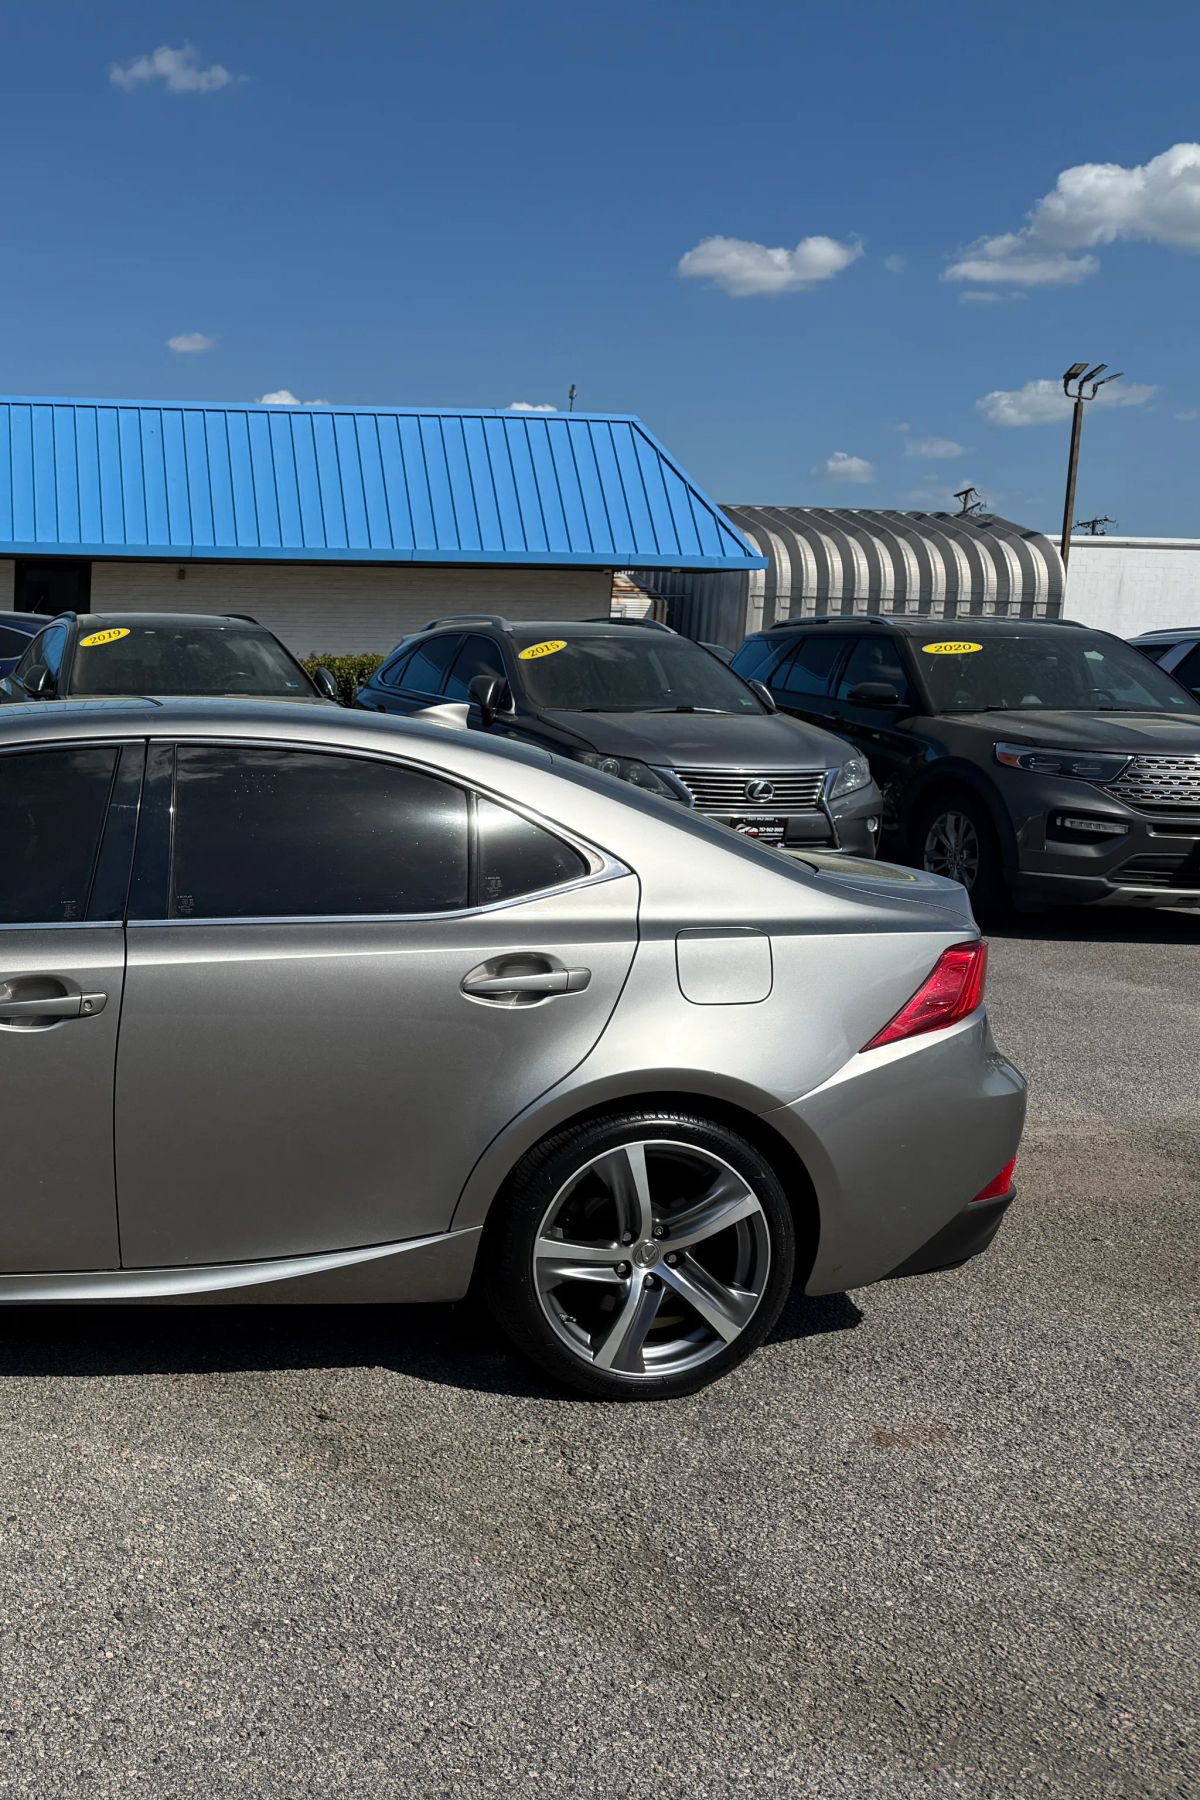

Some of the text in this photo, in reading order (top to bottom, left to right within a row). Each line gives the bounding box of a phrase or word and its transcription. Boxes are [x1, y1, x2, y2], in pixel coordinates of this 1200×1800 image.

[89, 629, 121, 644] 2019
[527, 641, 560, 657] 2015
[933, 643, 972, 653] 2020
